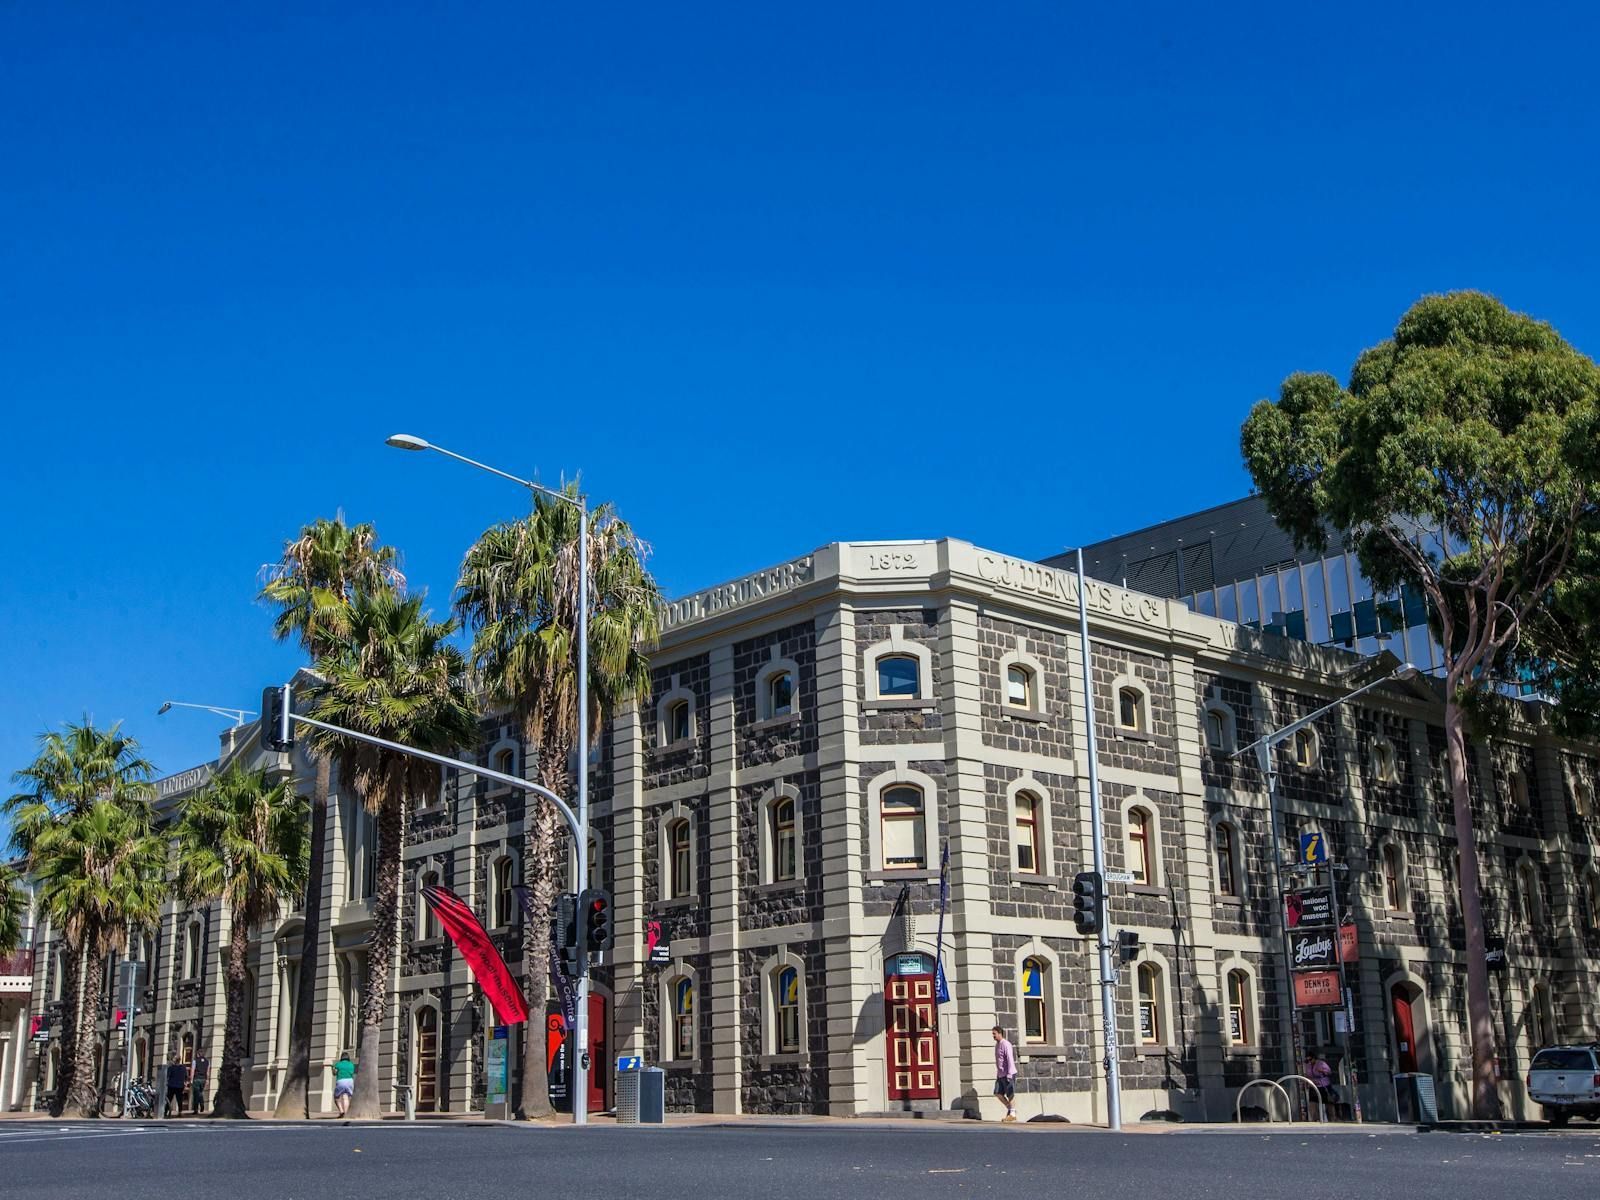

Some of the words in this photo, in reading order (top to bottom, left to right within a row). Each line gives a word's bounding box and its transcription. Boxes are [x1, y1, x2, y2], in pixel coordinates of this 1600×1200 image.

[870, 553, 919, 571] 1872
[706, 556, 811, 615] BROKERS
[1121, 592, 1136, 618] &
[1302, 895, 1329, 905] national
[1313, 904, 1329, 912] wool
[1302, 912, 1330, 920] museum
[1295, 936, 1333, 963] Lambys
[563, 986, 575, 1023] Centre
